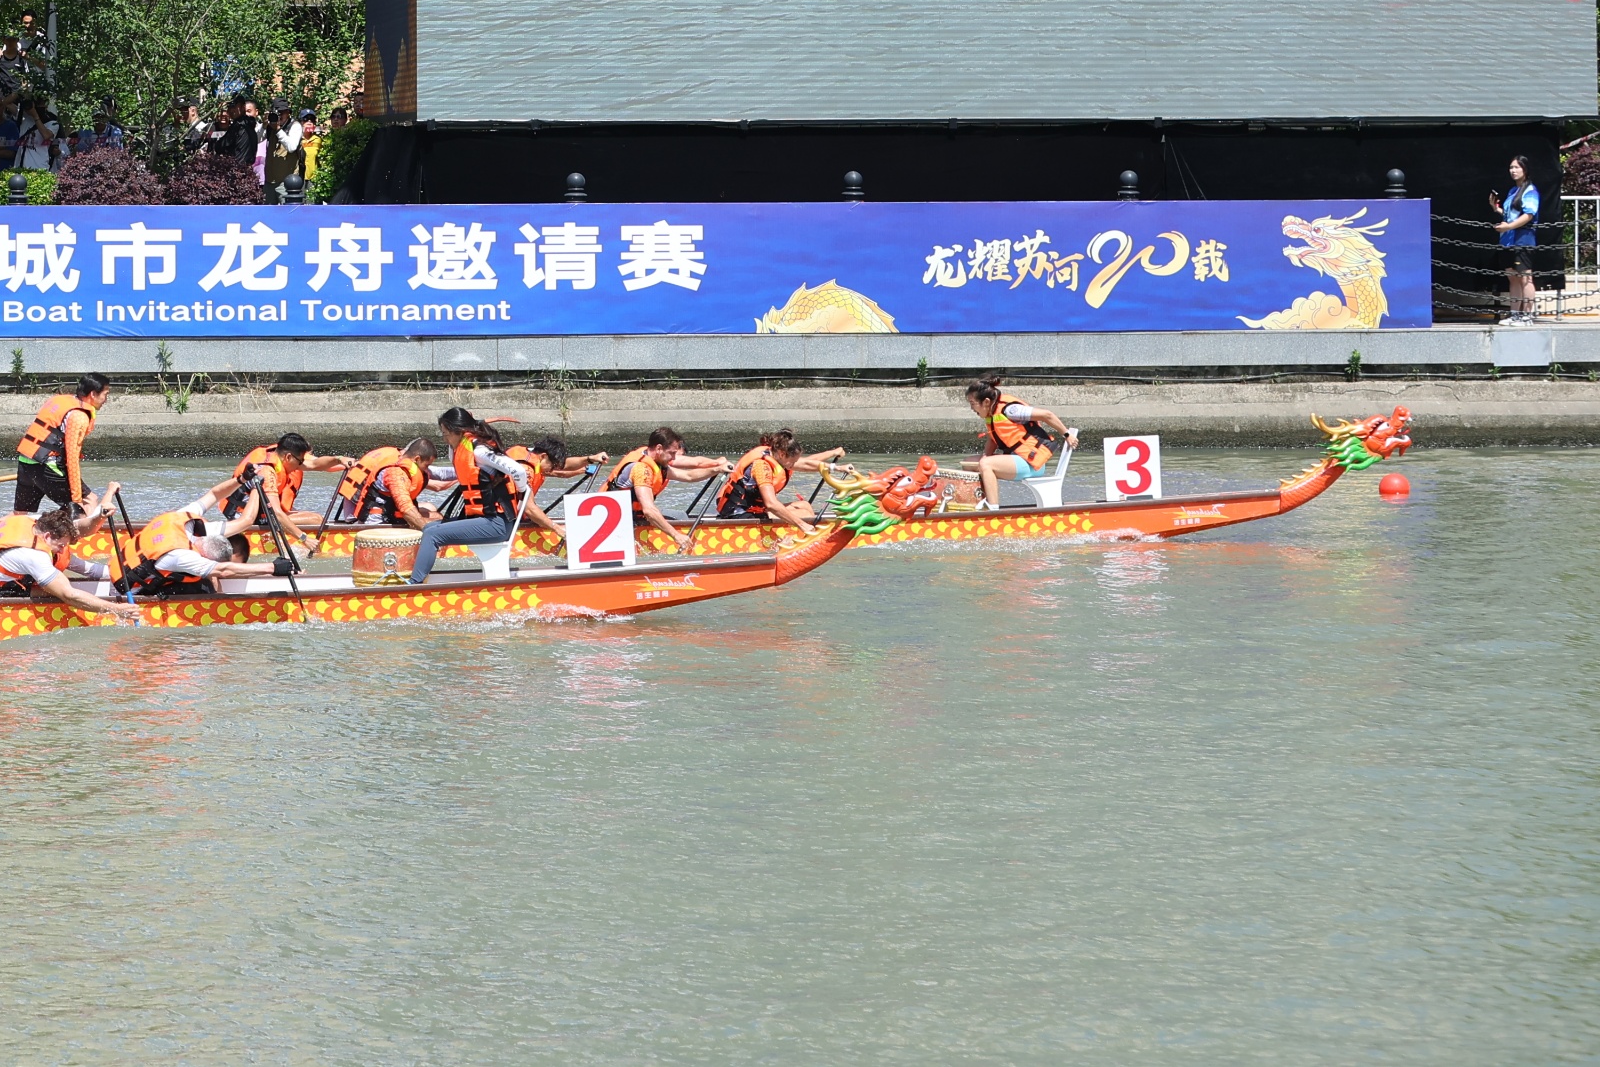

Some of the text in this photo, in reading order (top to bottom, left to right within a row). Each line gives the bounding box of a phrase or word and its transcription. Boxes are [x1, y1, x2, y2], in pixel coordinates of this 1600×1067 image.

[4, 301, 82, 322] Boat
[97, 300, 287, 322] Invitational
[300, 300, 511, 321] Tournament
[1115, 439, 1152, 495] 3
[576, 495, 626, 563] 2
